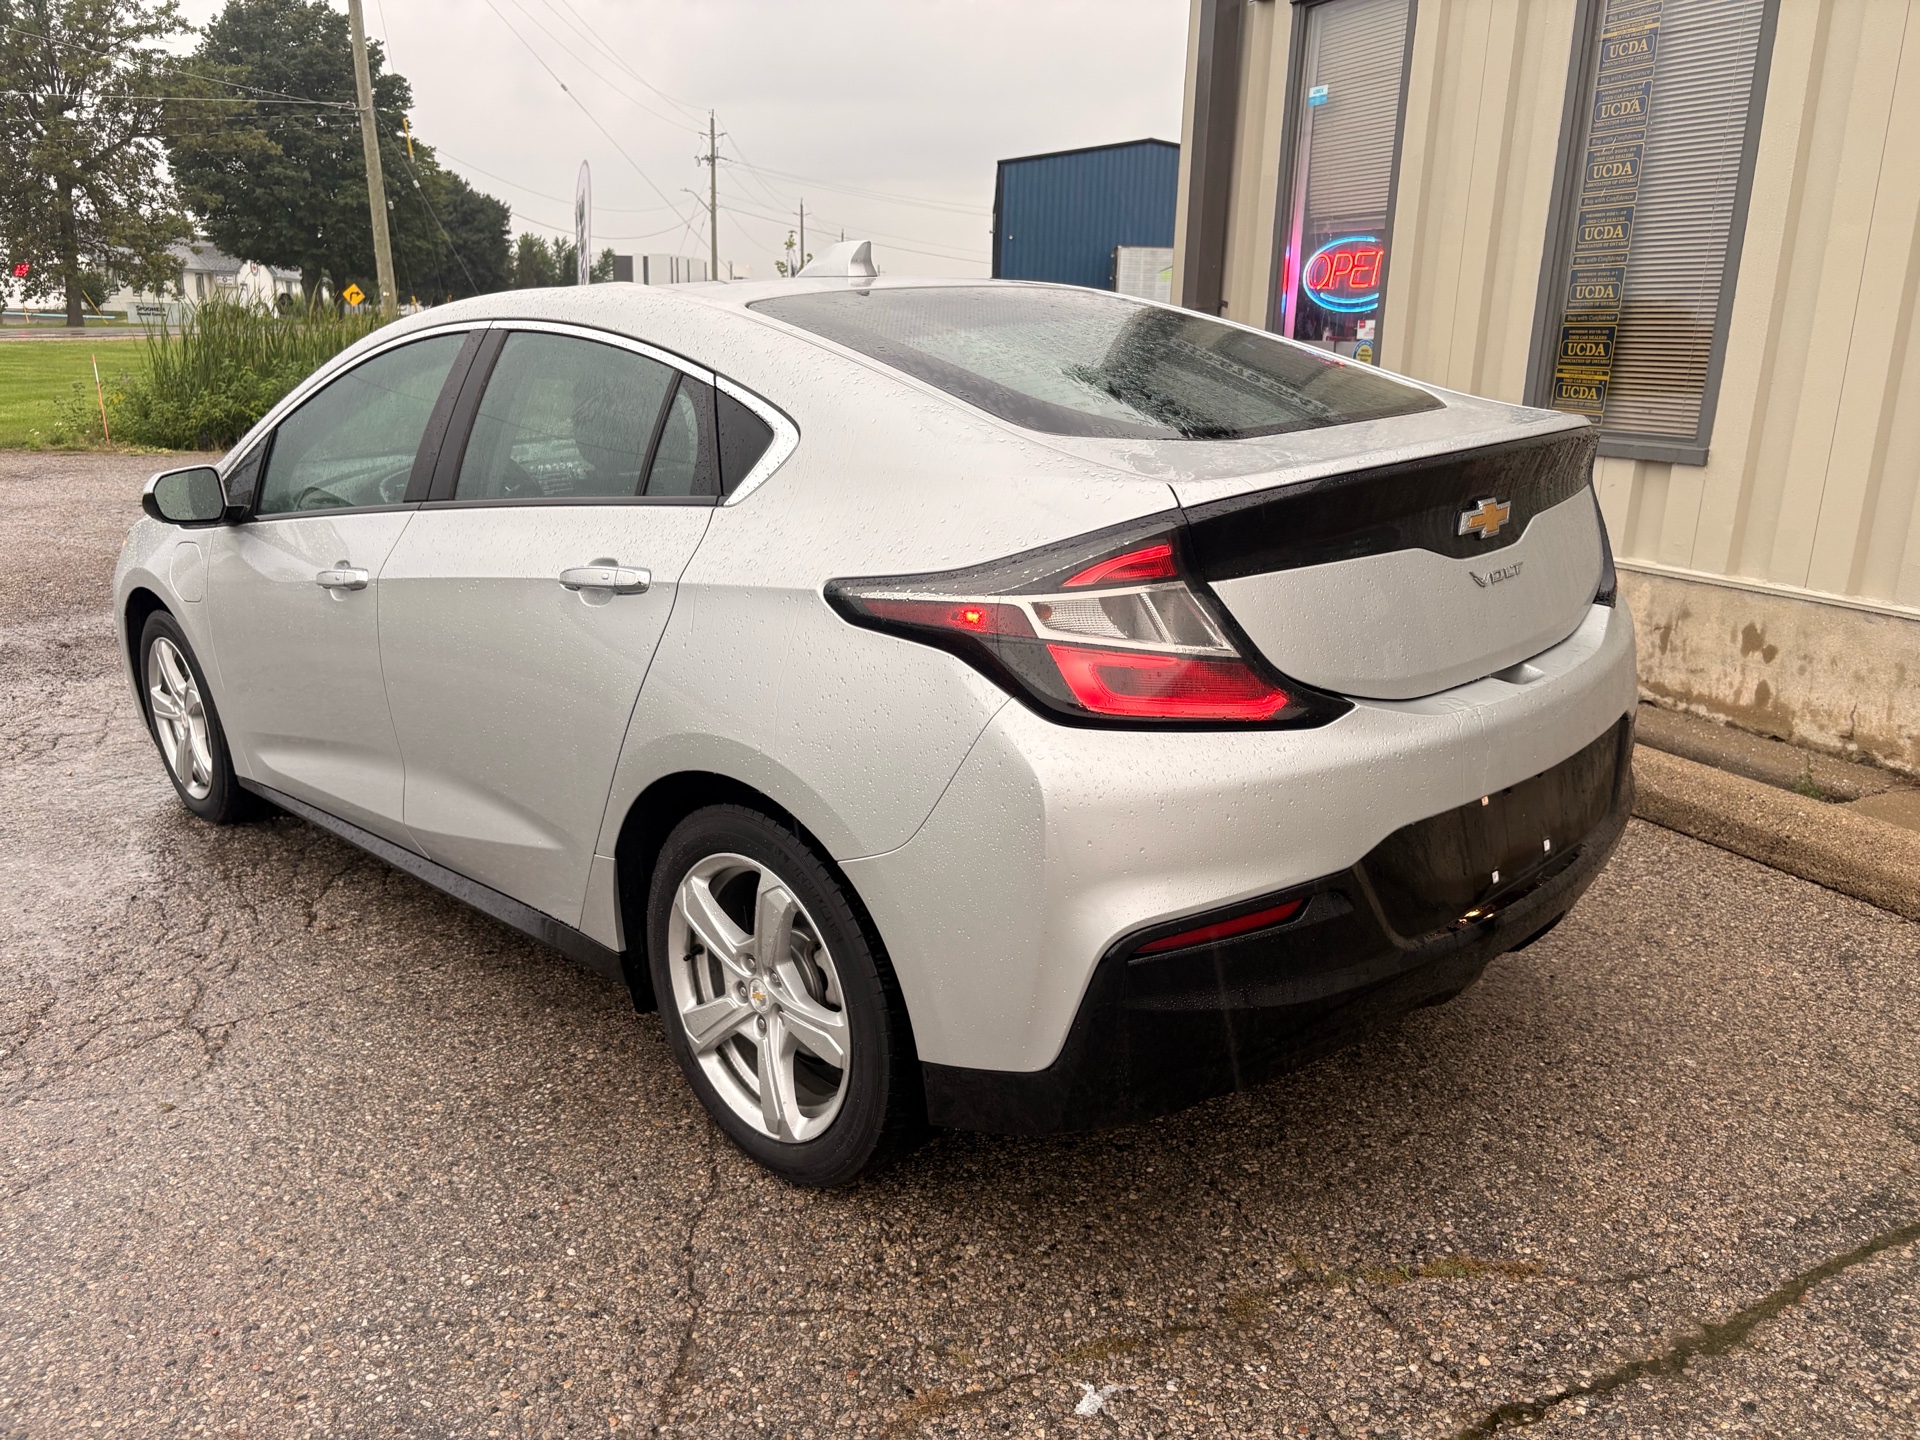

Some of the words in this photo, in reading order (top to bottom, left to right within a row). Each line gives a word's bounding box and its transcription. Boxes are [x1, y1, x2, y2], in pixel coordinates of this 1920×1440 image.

[1631, 6, 1659, 15] Confidence
[1610, 38, 1648, 58] UCDA
[1601, 100, 1641, 118] UCDA
[1593, 162, 1632, 178] UCDA
[1584, 225, 1623, 240] UCDA
[1576, 285, 1614, 299] UCDA
[1568, 343, 1605, 356] UCDA
[1562, 386, 1597, 400] UCDA
[1469, 562, 1523, 587] VOLT
